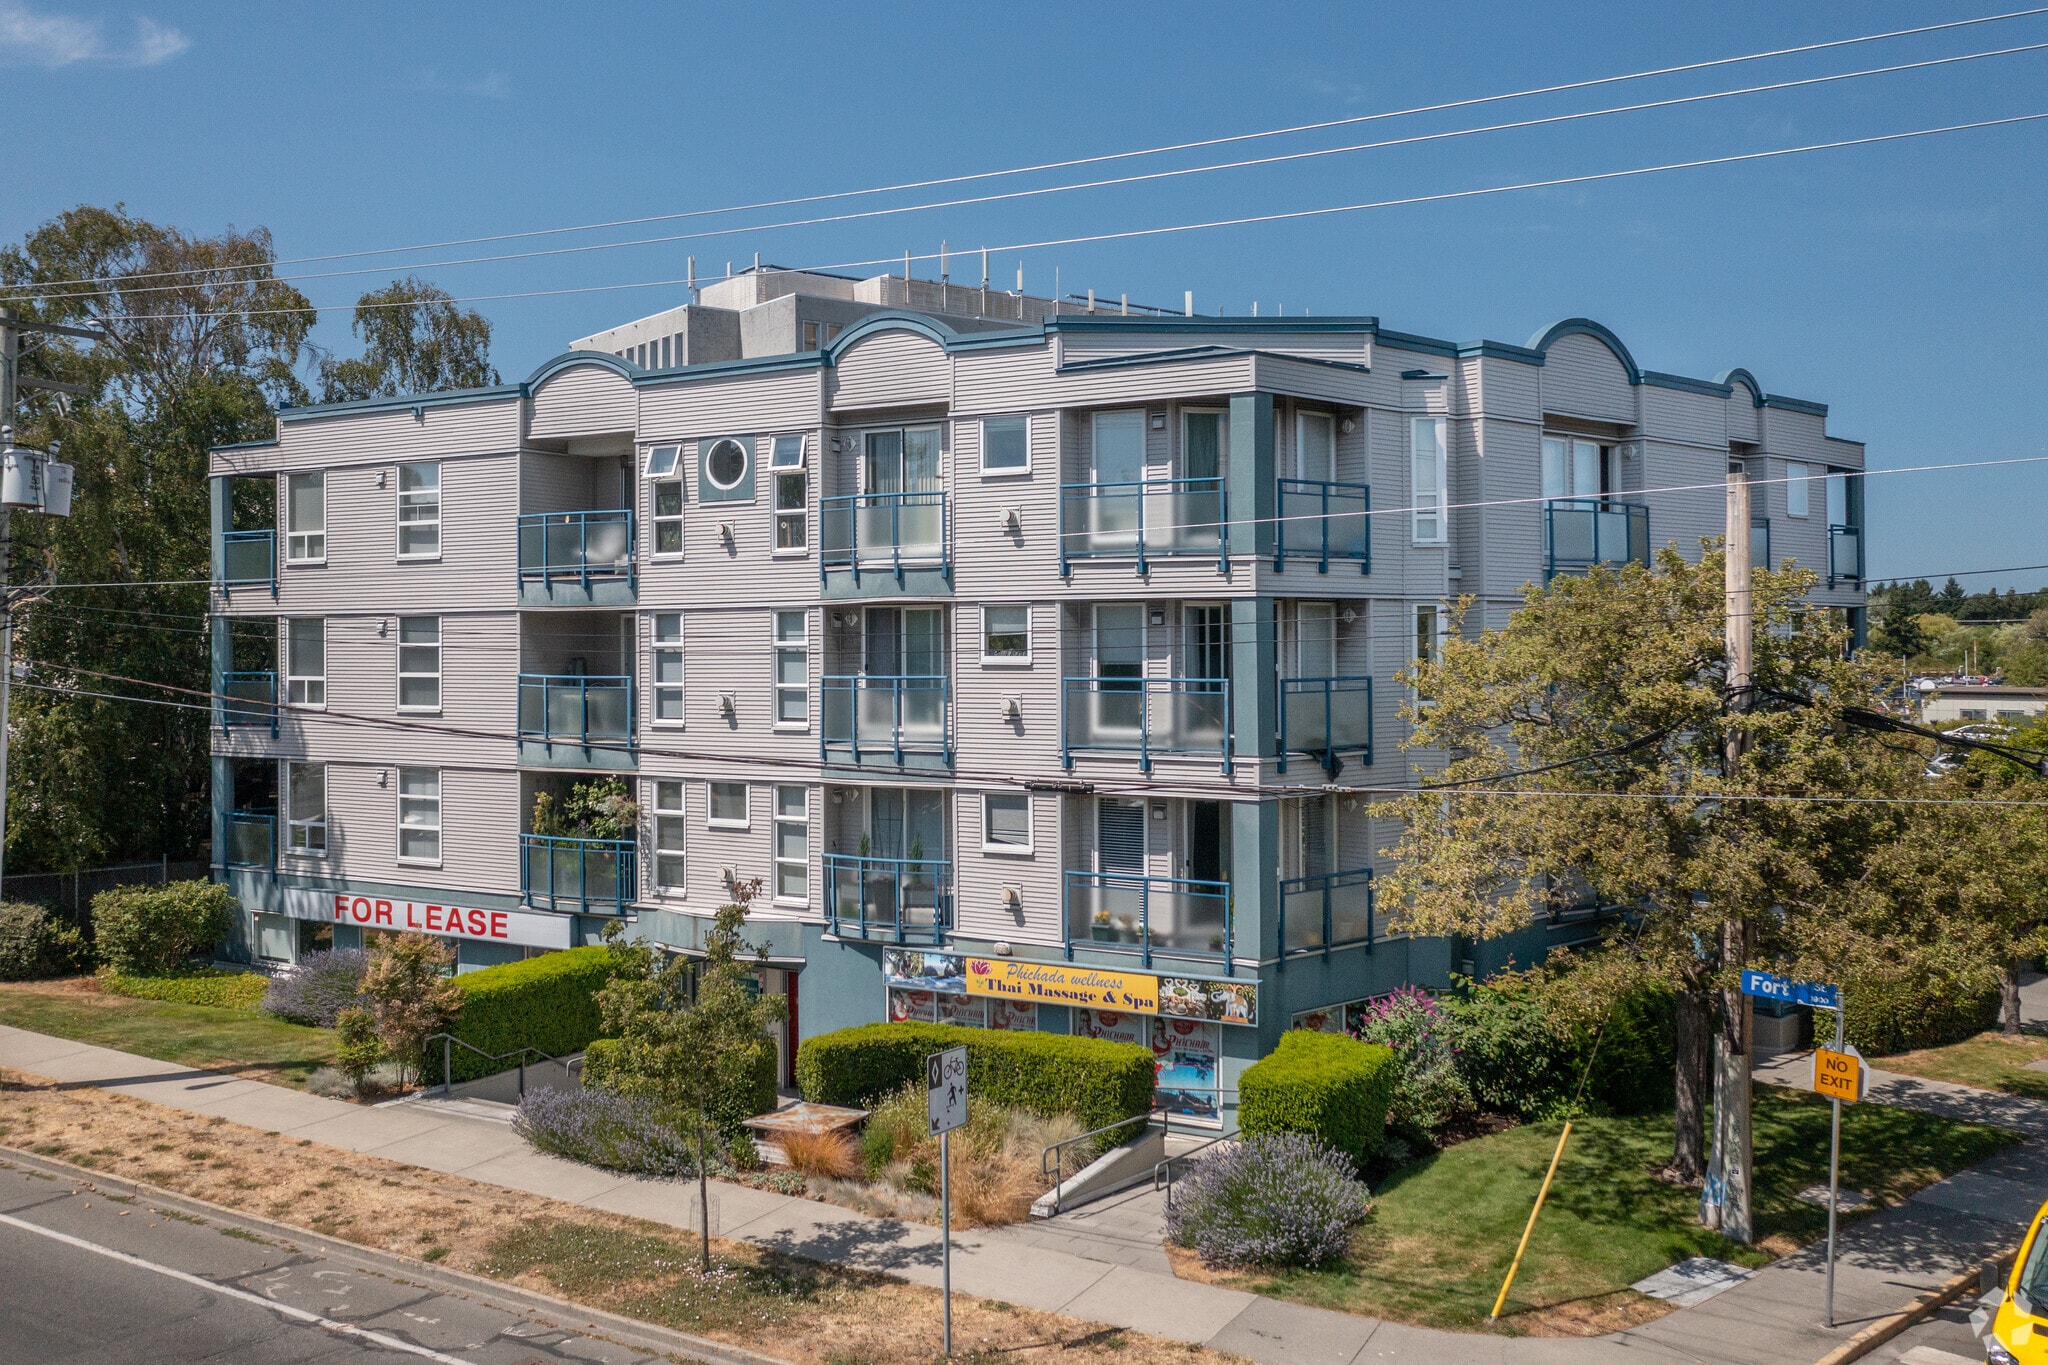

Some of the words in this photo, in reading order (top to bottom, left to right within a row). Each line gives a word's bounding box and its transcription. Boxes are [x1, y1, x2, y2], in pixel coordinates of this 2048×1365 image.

[334, 895, 393, 926] FOR
[406, 902, 508, 939] LEASE
[1006, 963, 1066, 984] Phichada
[1070, 972, 1124, 990] wellness
[1750, 974, 1790, 997] Fort
[985, 978, 1022, 994] Thai
[1028, 982, 1097, 1004] Massage
[1102, 990, 1117, 1004] &
[1122, 992, 1154, 1010] Spa
[1826, 1058, 1848, 1073] NO
[1820, 1073, 1853, 1091] EXIT
